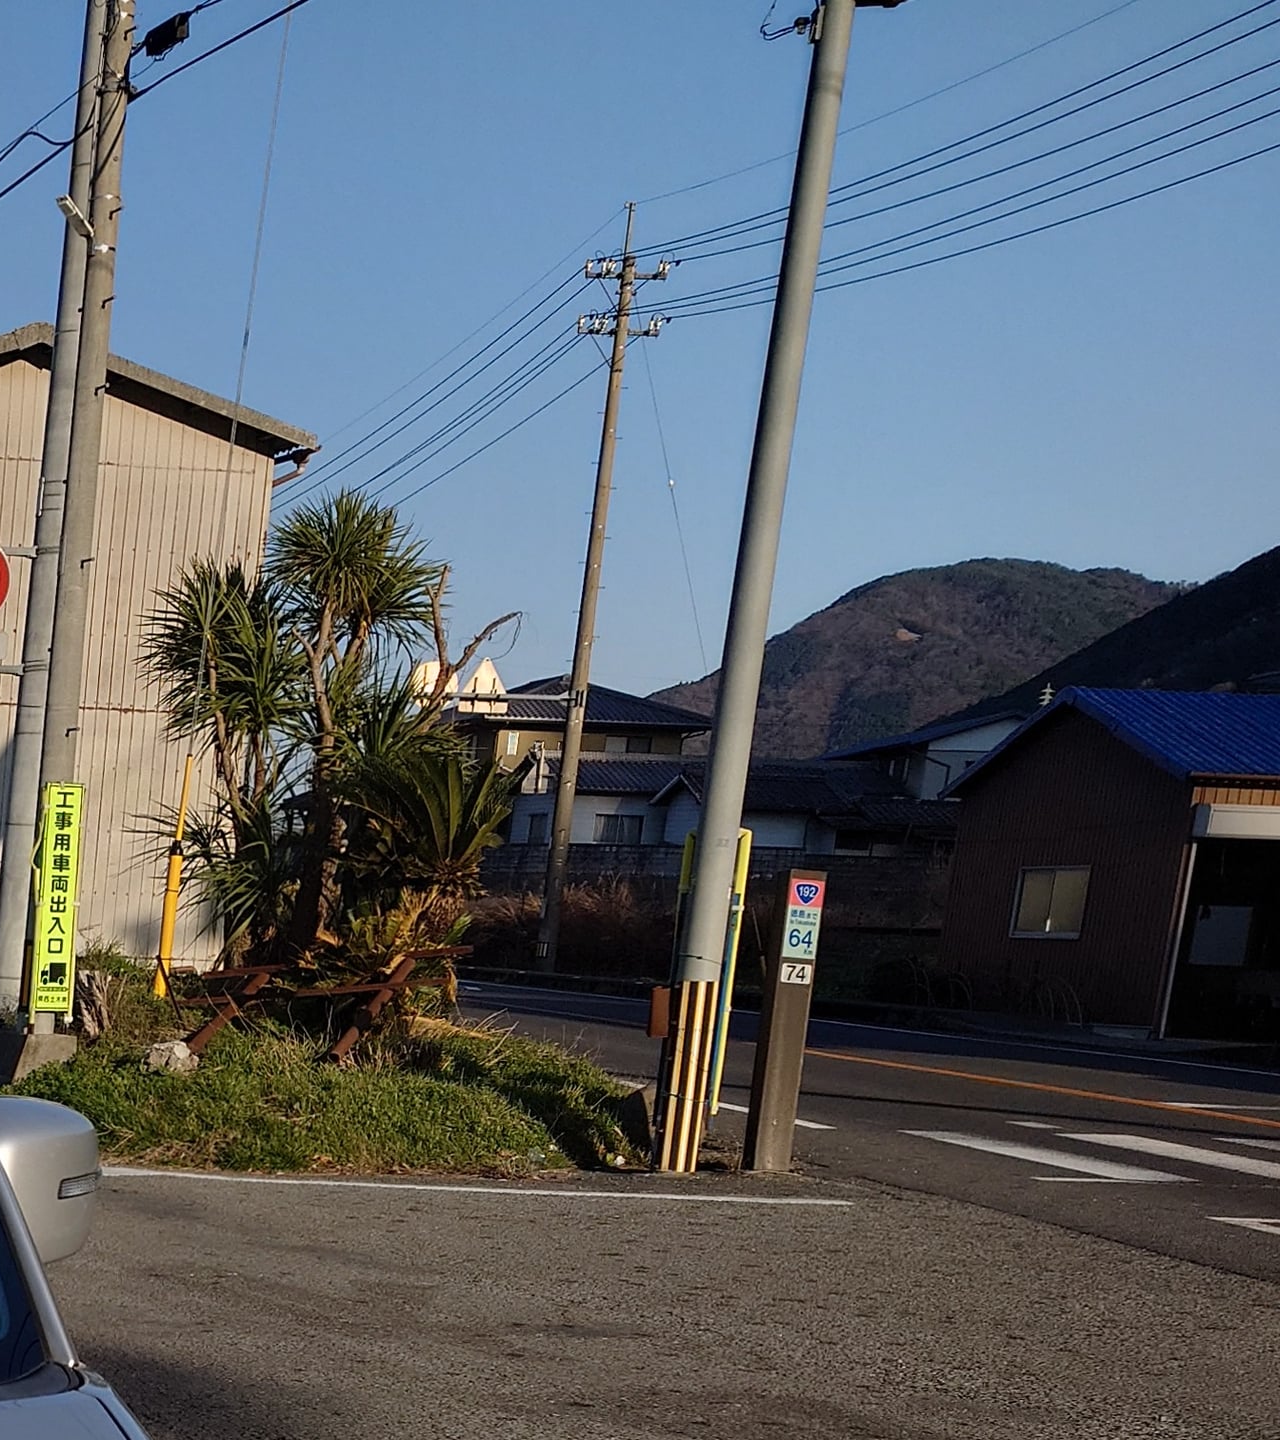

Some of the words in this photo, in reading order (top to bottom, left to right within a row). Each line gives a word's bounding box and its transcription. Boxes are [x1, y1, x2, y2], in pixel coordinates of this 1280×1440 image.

[47, 791, 75, 954] 工事用車両出入口
[799, 886, 816, 898] 192
[789, 929, 813, 948] 64
[786, 965, 806, 982] 74
